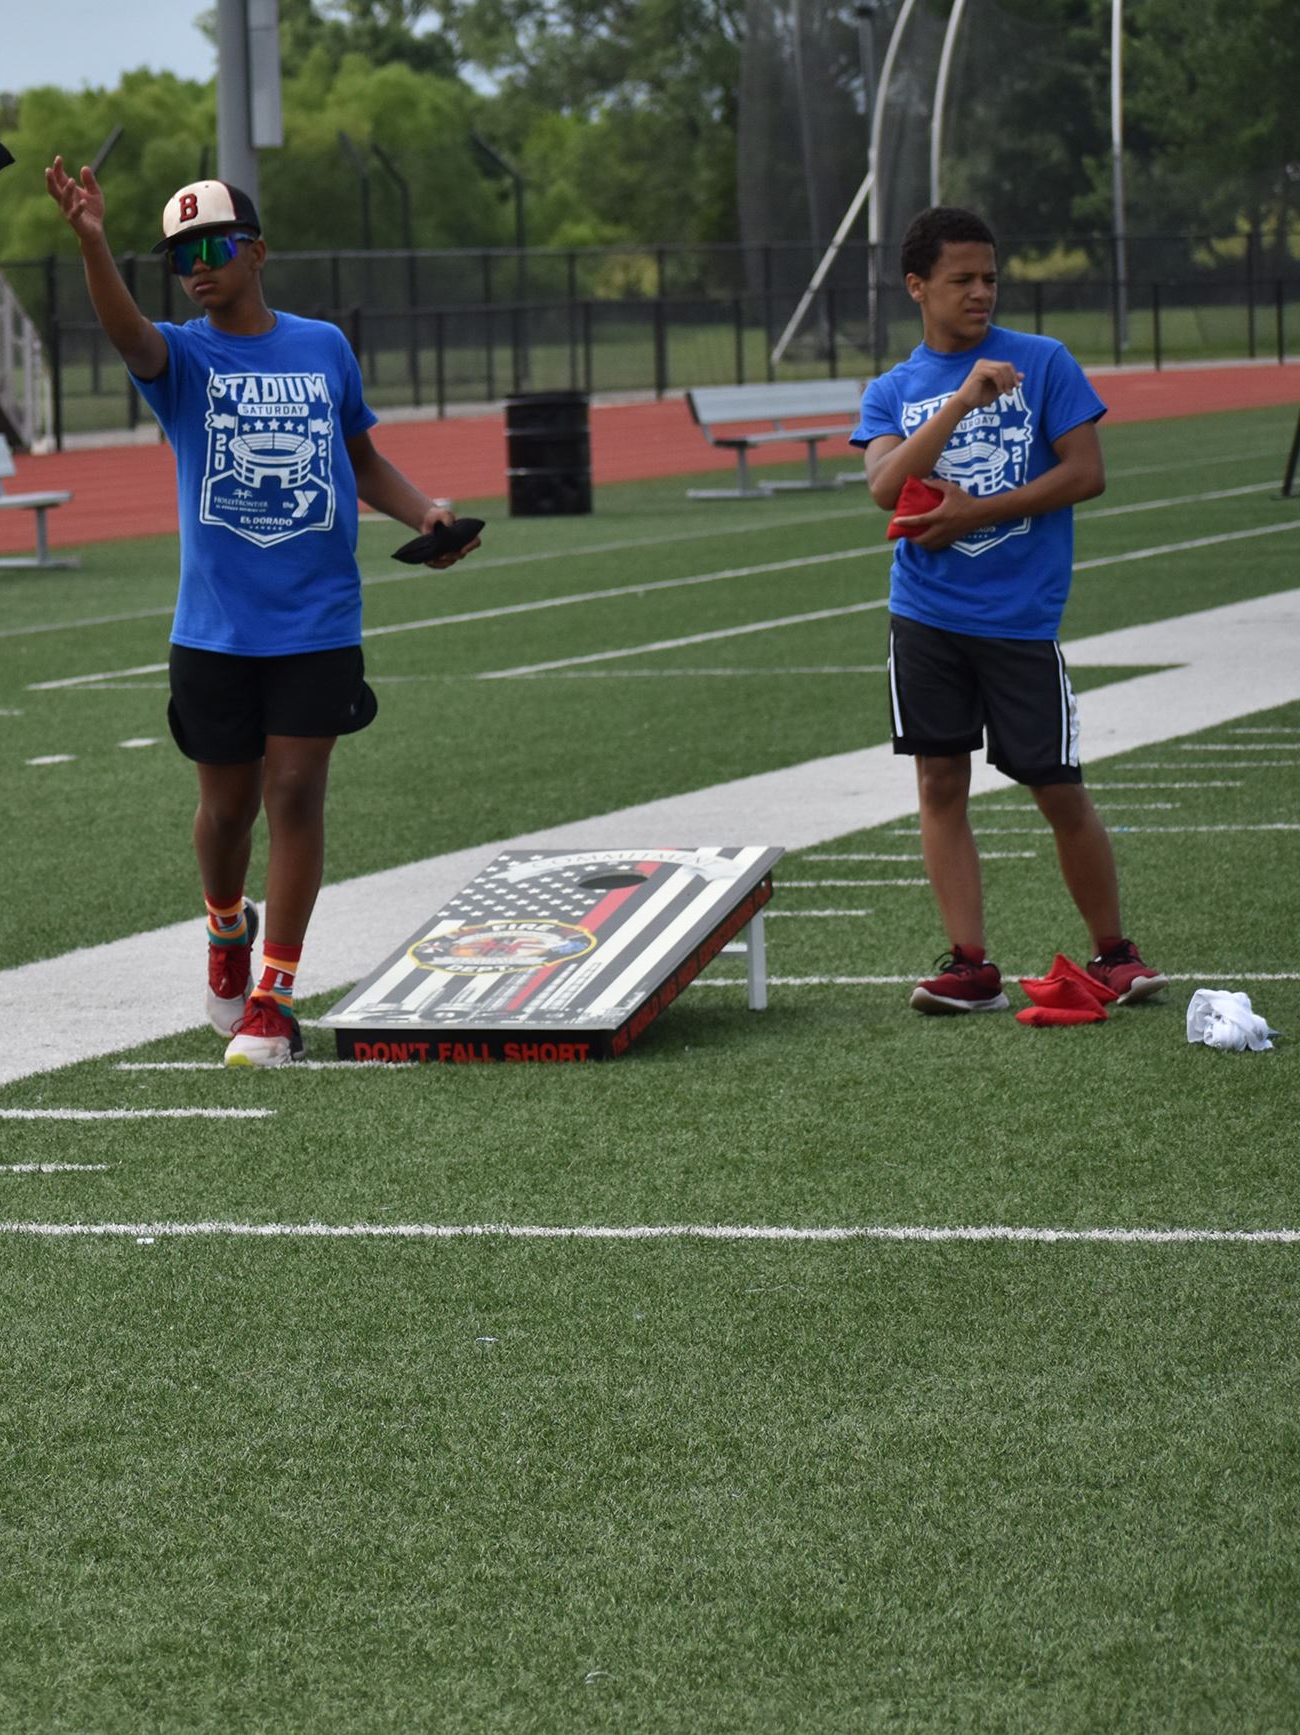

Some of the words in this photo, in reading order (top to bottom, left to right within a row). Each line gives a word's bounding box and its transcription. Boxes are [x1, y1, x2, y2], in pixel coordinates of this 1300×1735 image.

[179, 193, 198, 222] B
[211, 375, 327, 403] STADIUM
[242, 405, 304, 415] SATURDAY
[240, 516, 251, 524] EL
[253, 517, 293, 526] DORADO
[491, 923, 556, 932] FIRE
[353, 1042, 430, 1063] DON'T
[437, 1042, 496, 1063] FALL
[503, 1042, 589, 1063] SHORT
